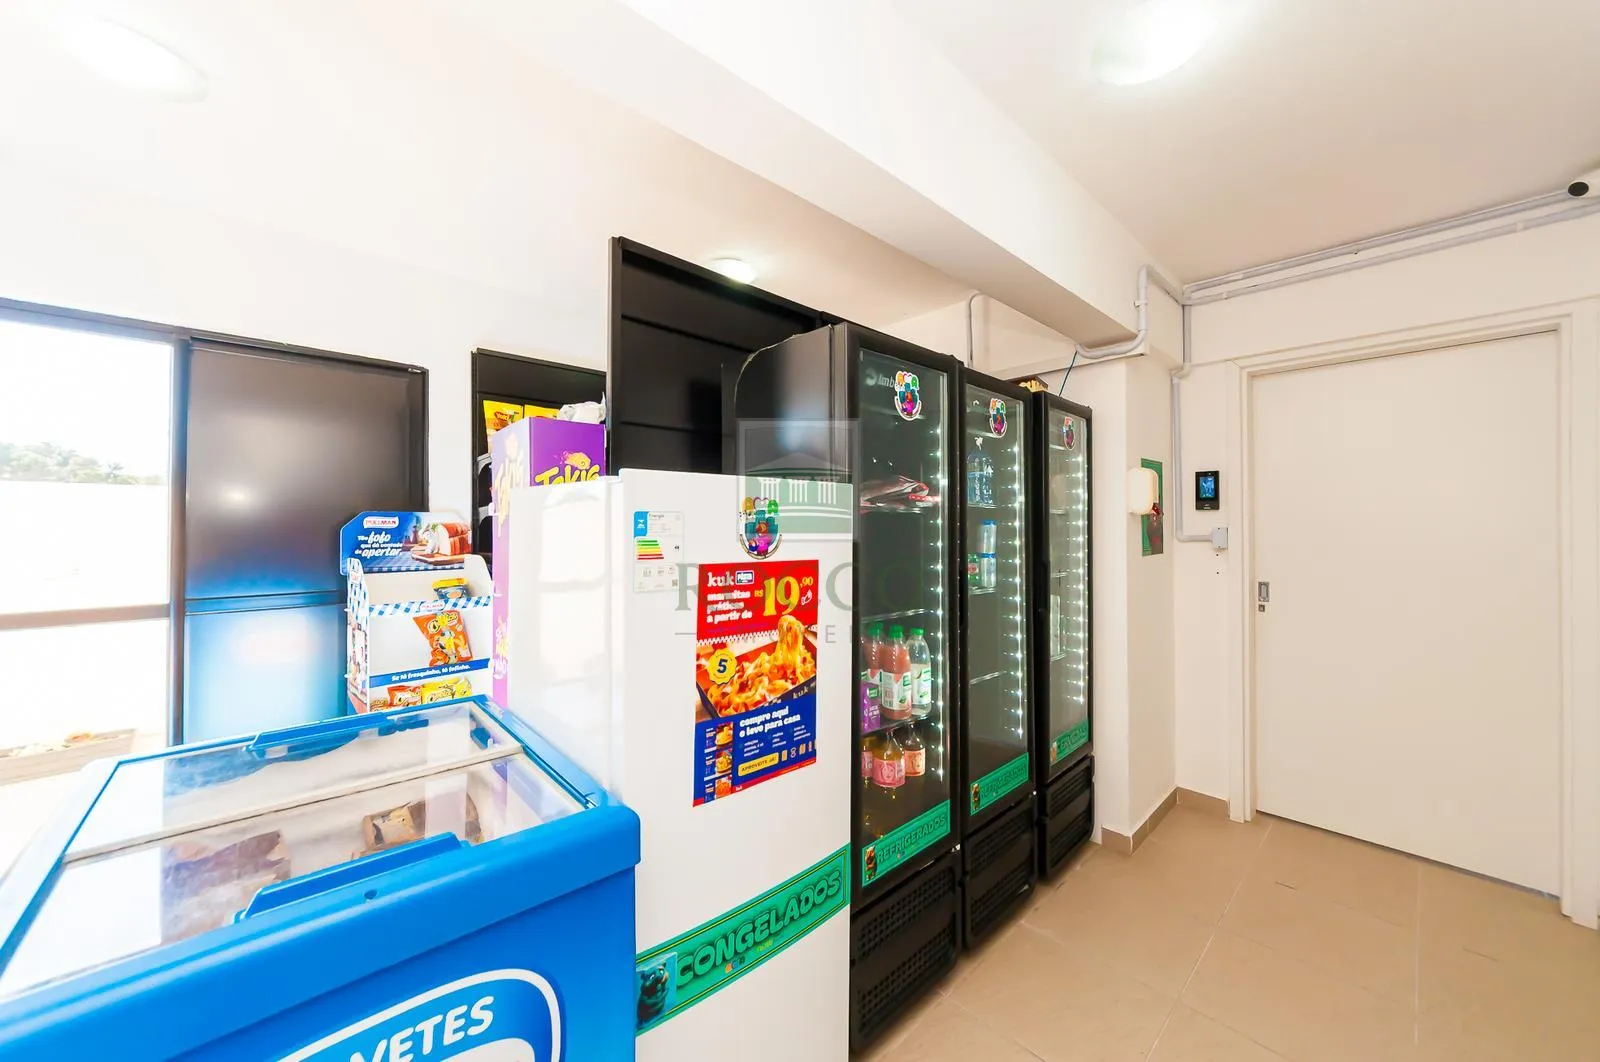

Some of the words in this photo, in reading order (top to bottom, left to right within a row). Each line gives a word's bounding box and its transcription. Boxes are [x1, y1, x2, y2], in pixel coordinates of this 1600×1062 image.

[707, 571, 735, 587] kuk
[706, 615, 713, 623] a
[714, 611, 741, 624] partir
[741, 610, 753, 619] de
[716, 658, 728, 673] 5
[740, 712, 771, 727] compre
[771, 706, 789, 719] aqui
[764, 719, 784, 733] para
[783, 714, 801, 725] casa
[877, 814, 946, 863] REFRIGERADOS
[675, 868, 842, 988] CONGELADOS
